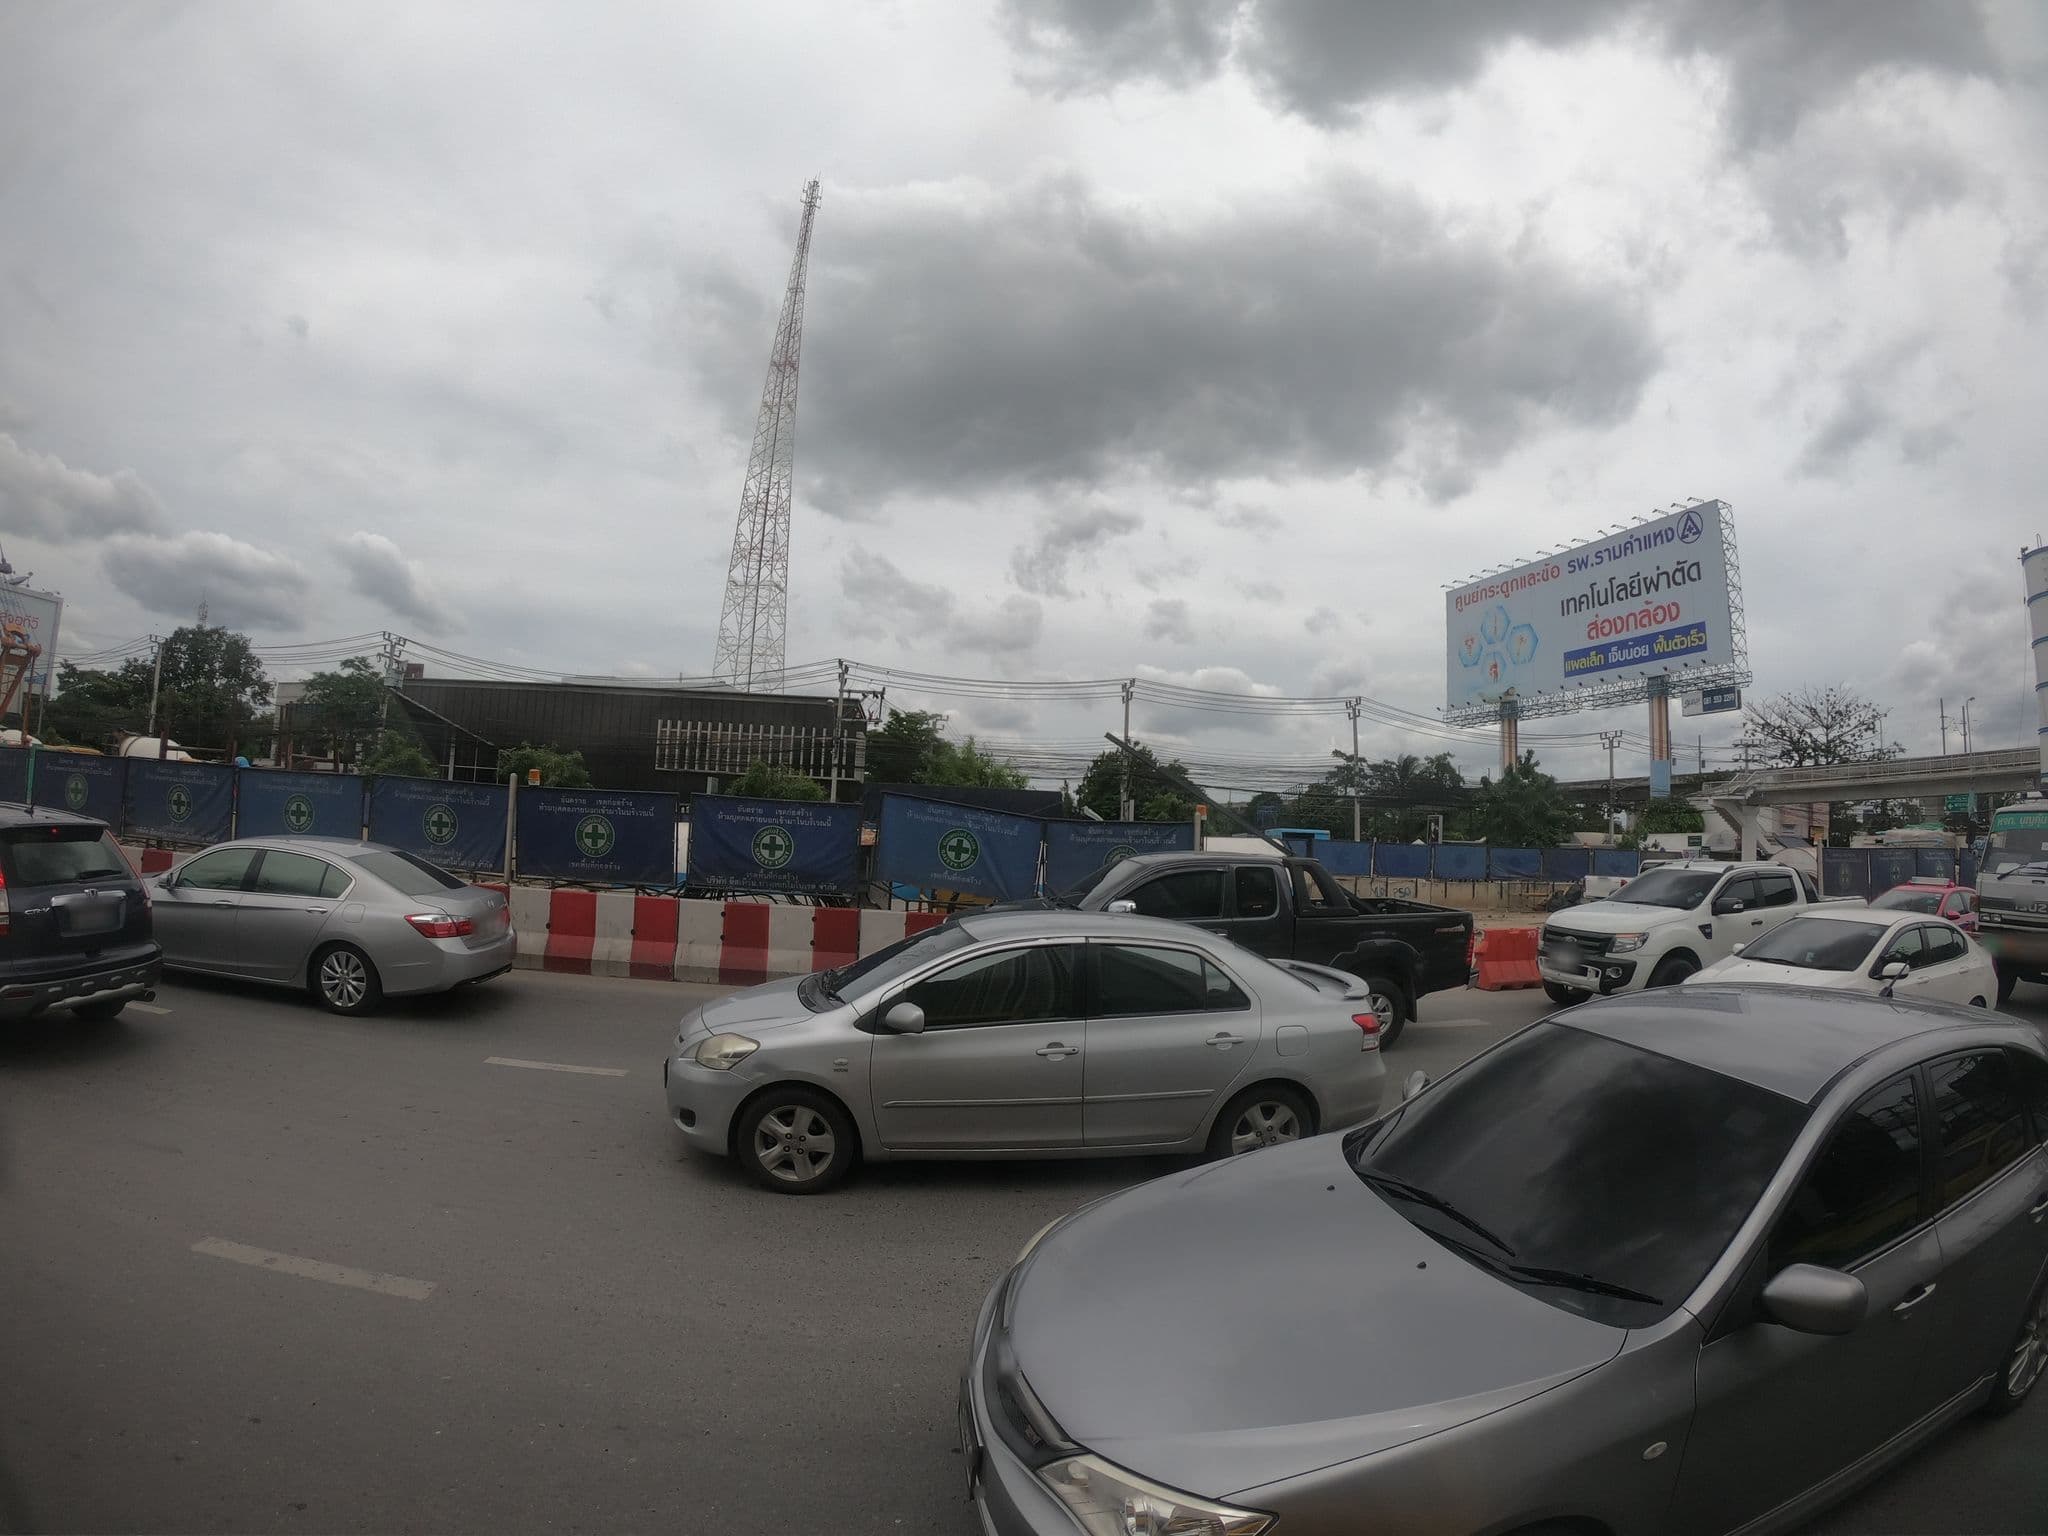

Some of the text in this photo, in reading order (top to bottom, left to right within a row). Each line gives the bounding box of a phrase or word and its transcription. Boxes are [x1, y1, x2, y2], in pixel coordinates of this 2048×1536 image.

[1455, 526, 1675, 613] ศูนย์กระดูกและข้อ รพ.รามคำแหง
[1561, 559, 1702, 616] เทคโนโลยีผ่าตัด
[1587, 600, 1681, 641] ส่องกล้อง
[1565, 629, 1707, 673] แผลเล็ก เจ็บน้อย ฟื้นตัวเร็ว
